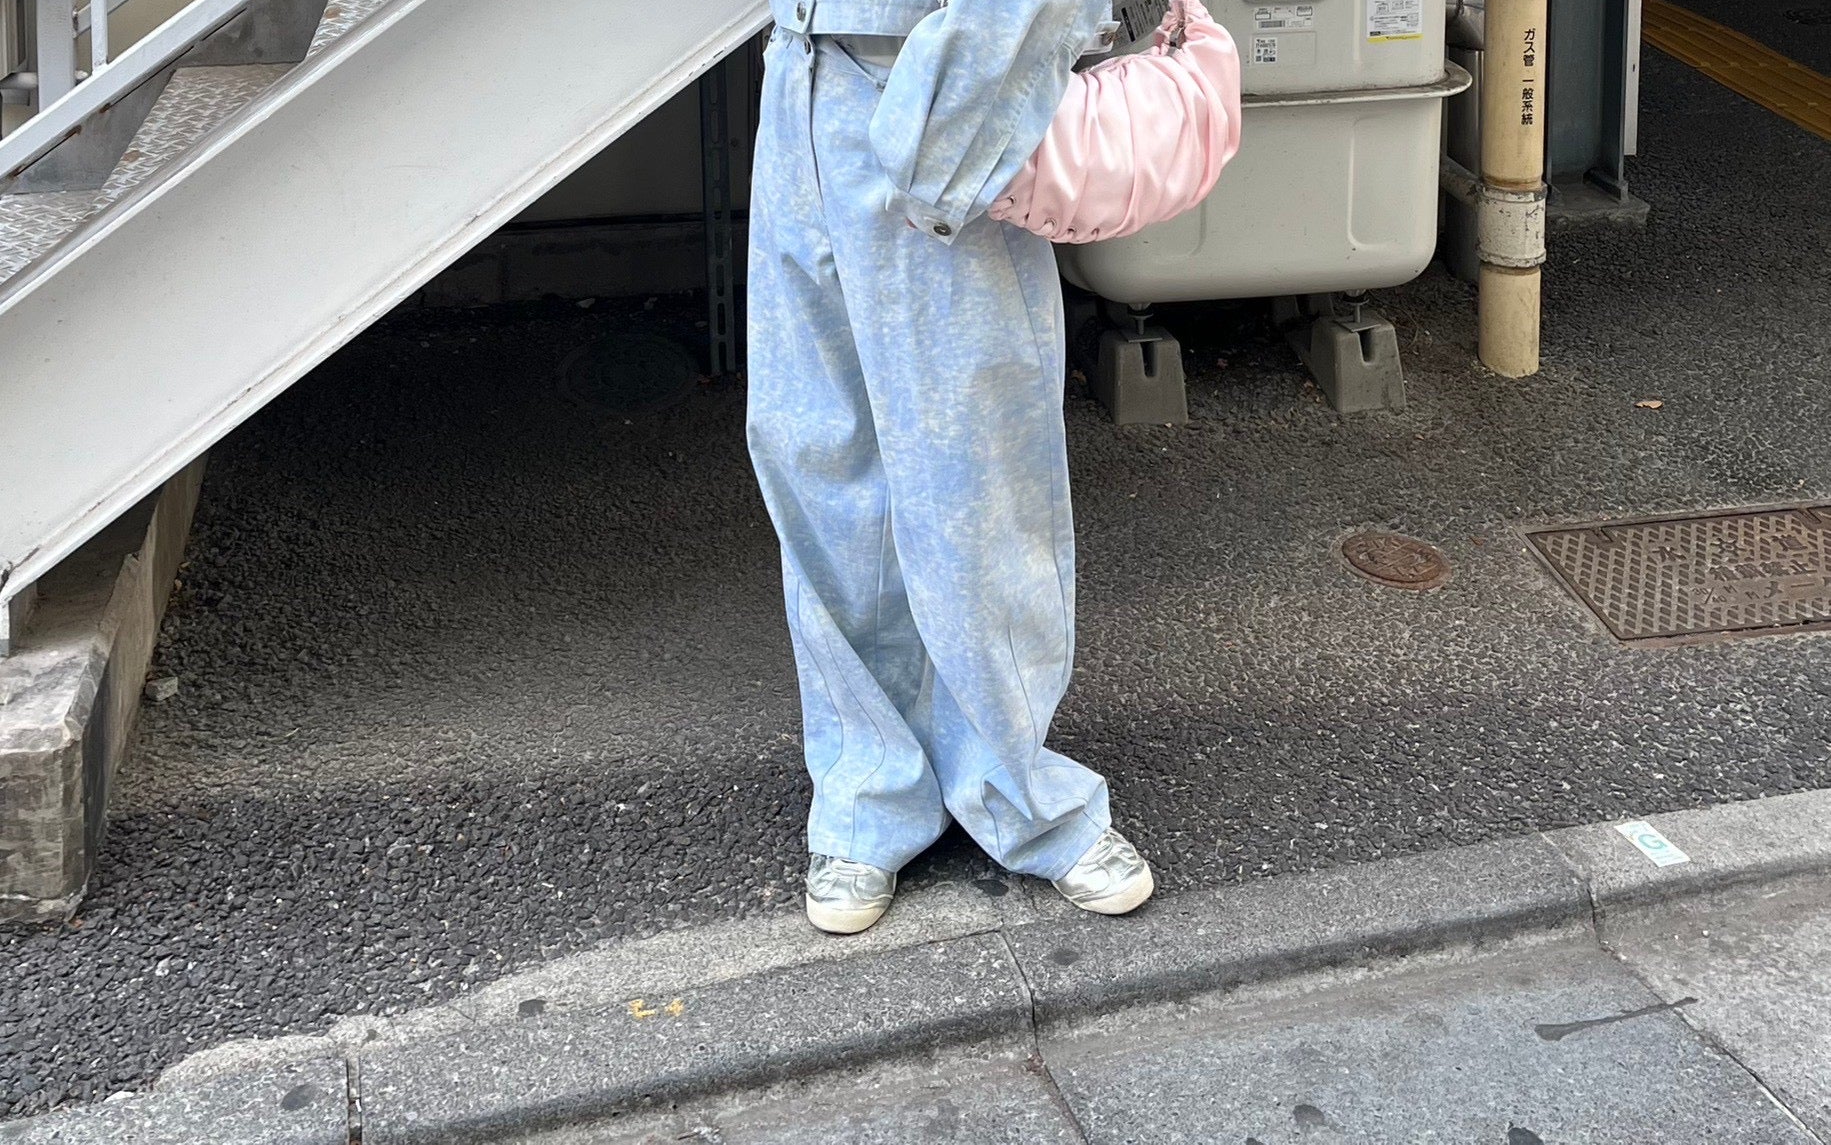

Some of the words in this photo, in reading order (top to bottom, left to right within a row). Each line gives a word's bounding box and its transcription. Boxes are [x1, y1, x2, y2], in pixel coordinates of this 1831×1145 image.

[1523, 28, 1536, 67] ガス管
[1521, 79, 1534, 126] 一般系統
